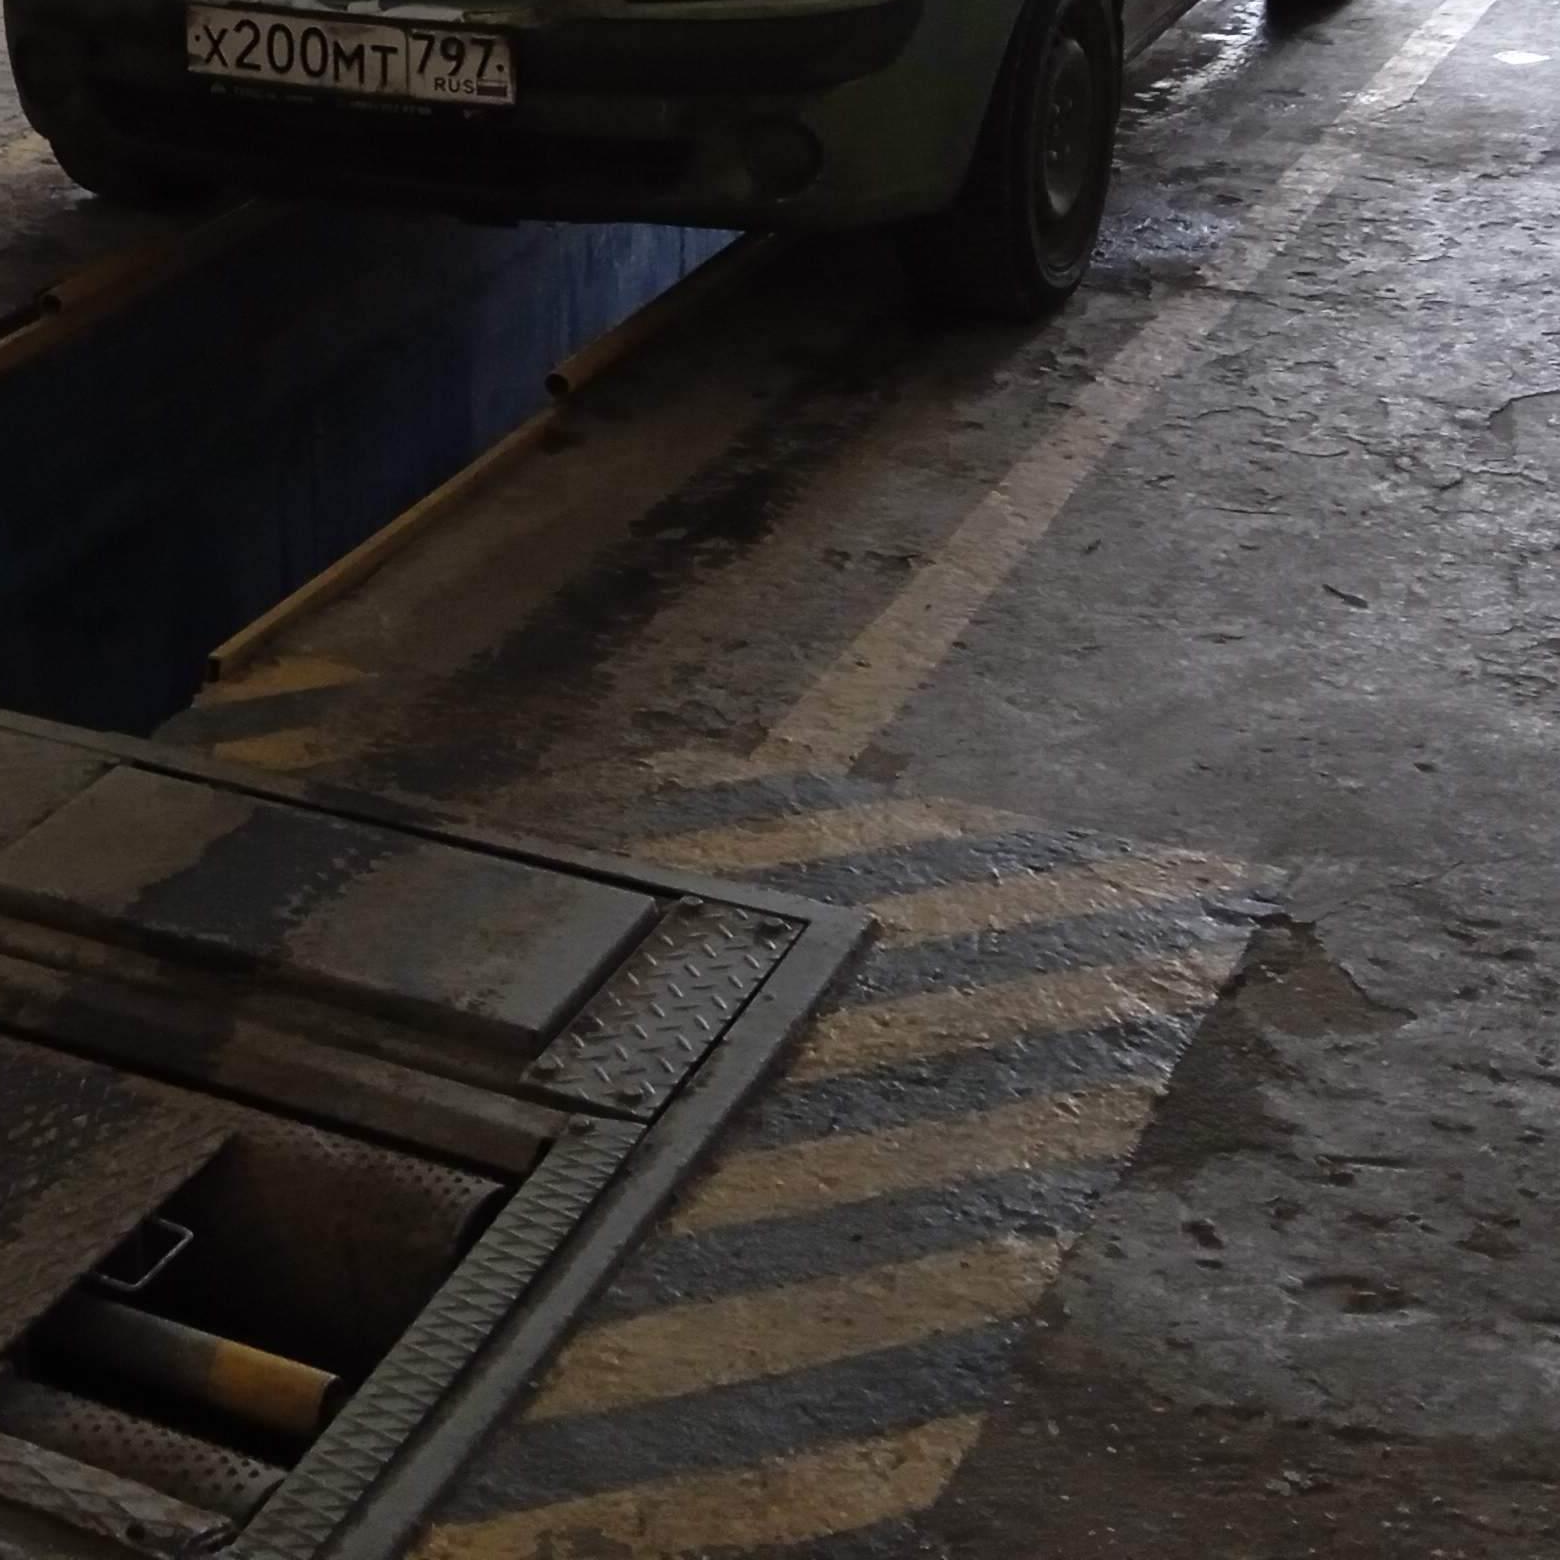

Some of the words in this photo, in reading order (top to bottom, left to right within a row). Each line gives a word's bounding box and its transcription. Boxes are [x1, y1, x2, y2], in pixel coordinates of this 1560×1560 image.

[203, 19, 399, 87] Х200МТ
[412, 33, 497, 79] 797
[434, 77, 475, 95] RUS
